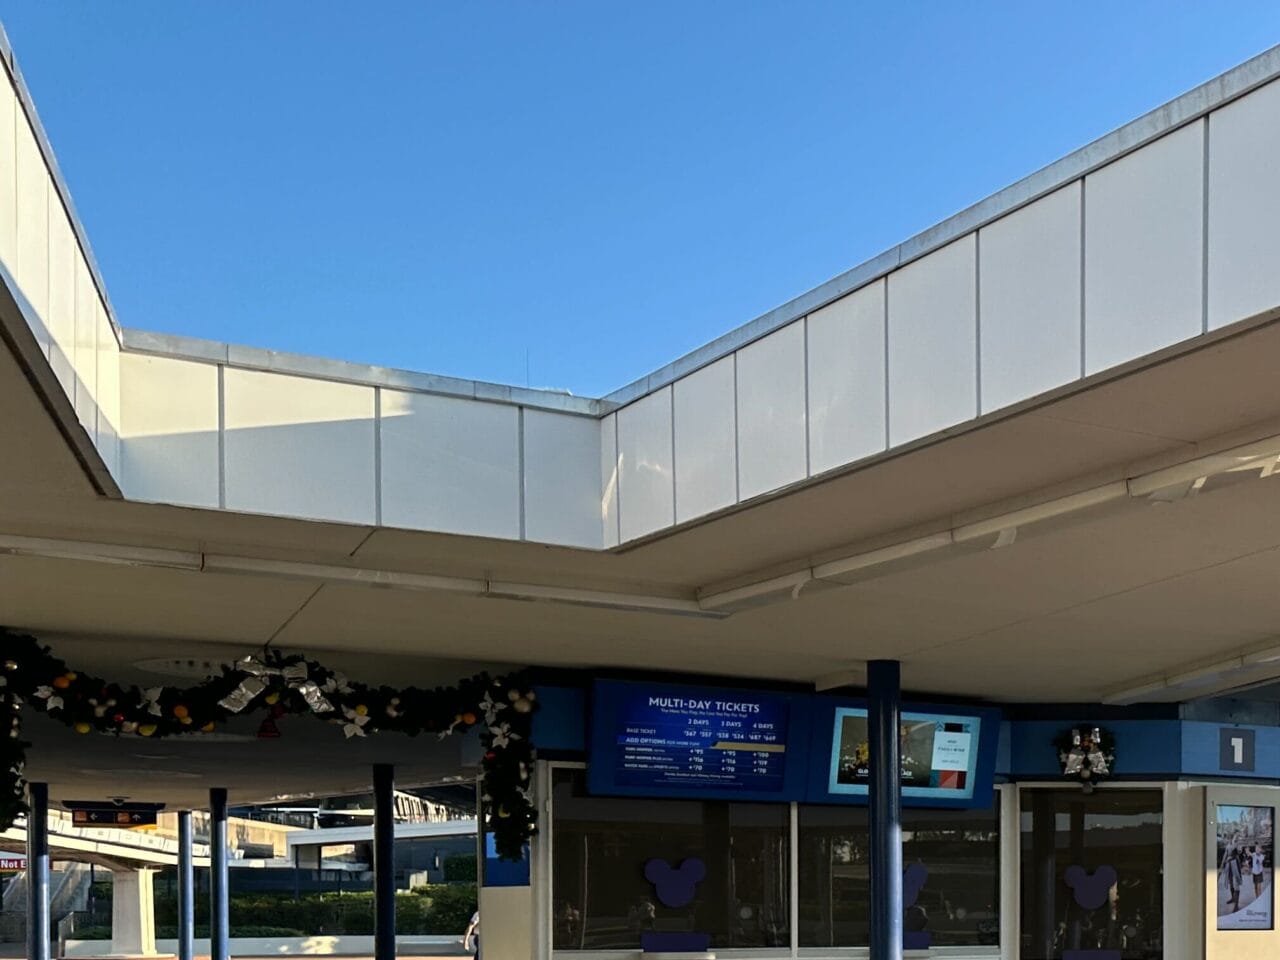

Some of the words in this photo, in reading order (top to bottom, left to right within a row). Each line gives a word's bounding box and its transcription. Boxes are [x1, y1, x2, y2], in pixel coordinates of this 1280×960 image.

[649, 697, 711, 710] MULTI-DAY
[715, 701, 760, 713] TICKETS
[1231, 737, 1243, 763] 1
[0, 860, 18, 869] Not
[20, 860, 27, 869] E
